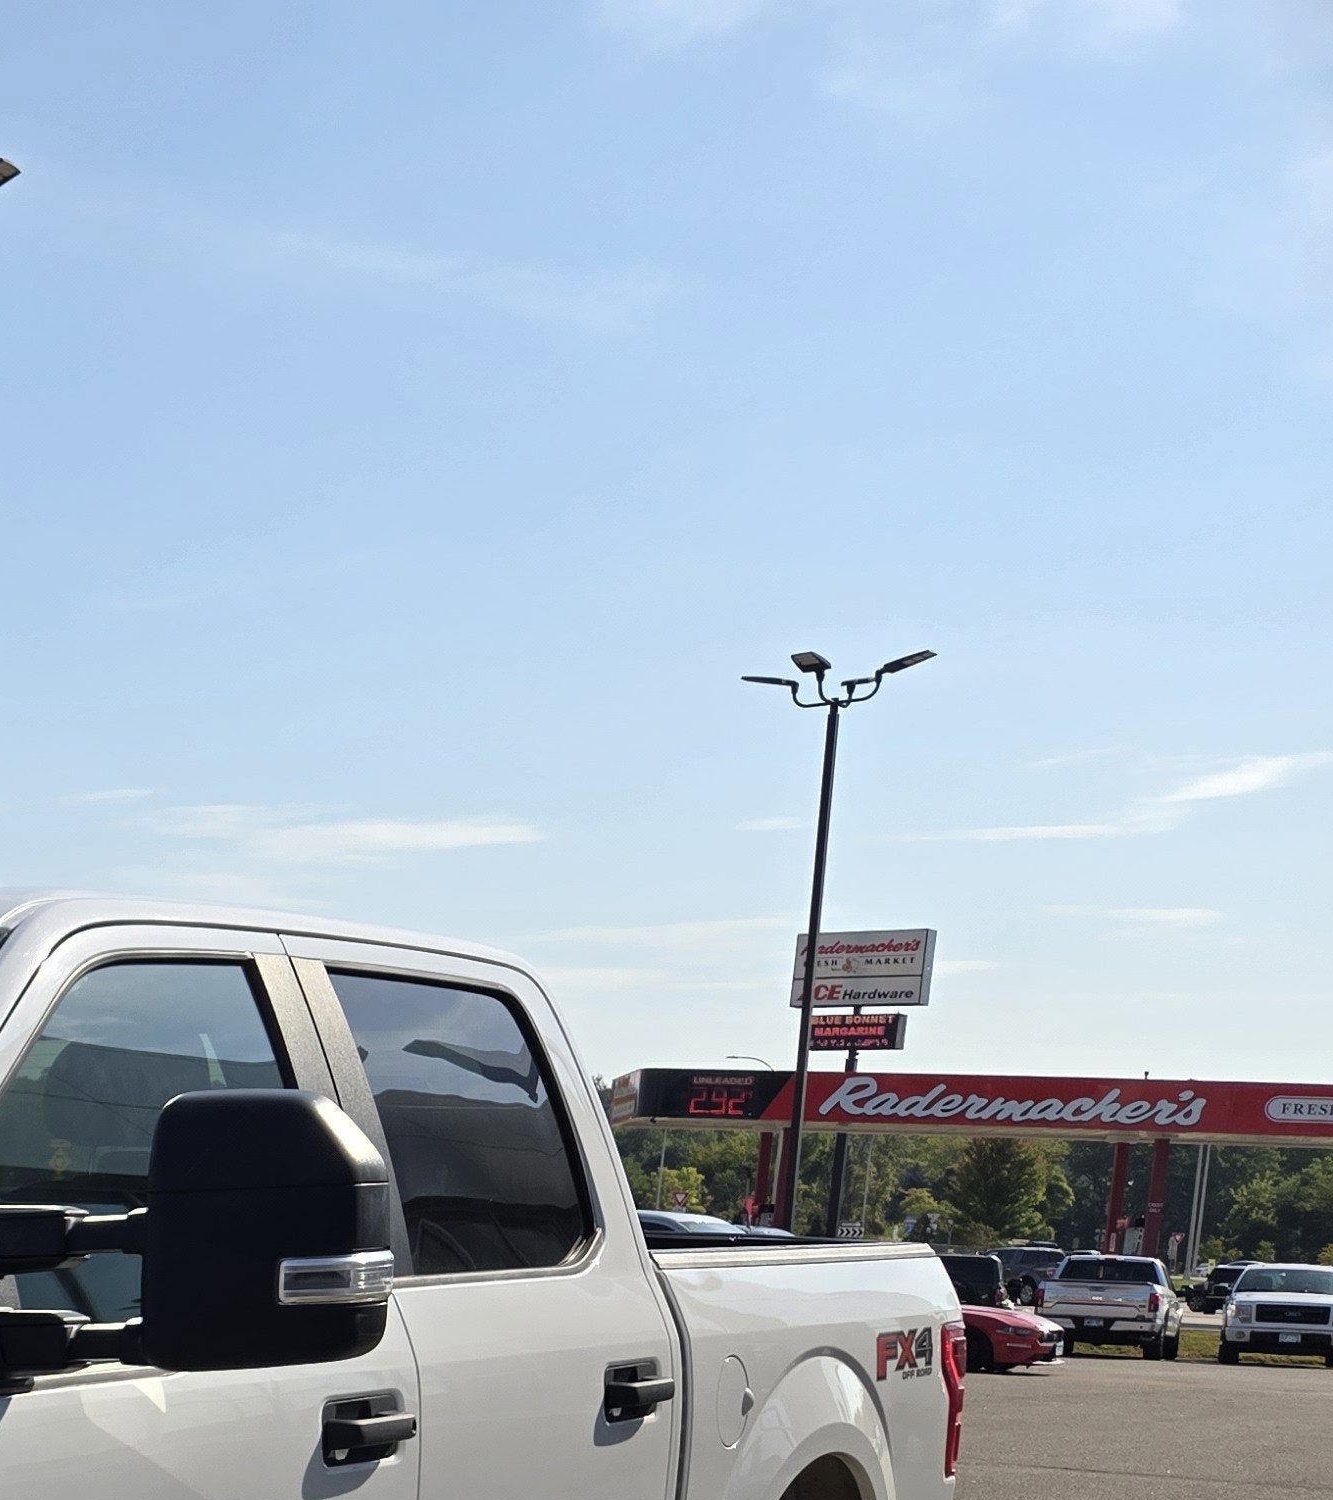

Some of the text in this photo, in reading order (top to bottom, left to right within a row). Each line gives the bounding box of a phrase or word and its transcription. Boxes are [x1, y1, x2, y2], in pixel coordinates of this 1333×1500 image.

[864, 957, 915, 965] MARKET
[798, 984, 914, 1001] CE Hardware
[845, 1014, 894, 1024] BONNET
[814, 1026, 885, 1036] MARGARINE
[693, 1076, 753, 1085] UNLEADED
[818, 1076, 1207, 1126] Radermacher's
[876, 1326, 933, 1381] FX4
[902, 1367, 932, 1380] OFF ROAD
